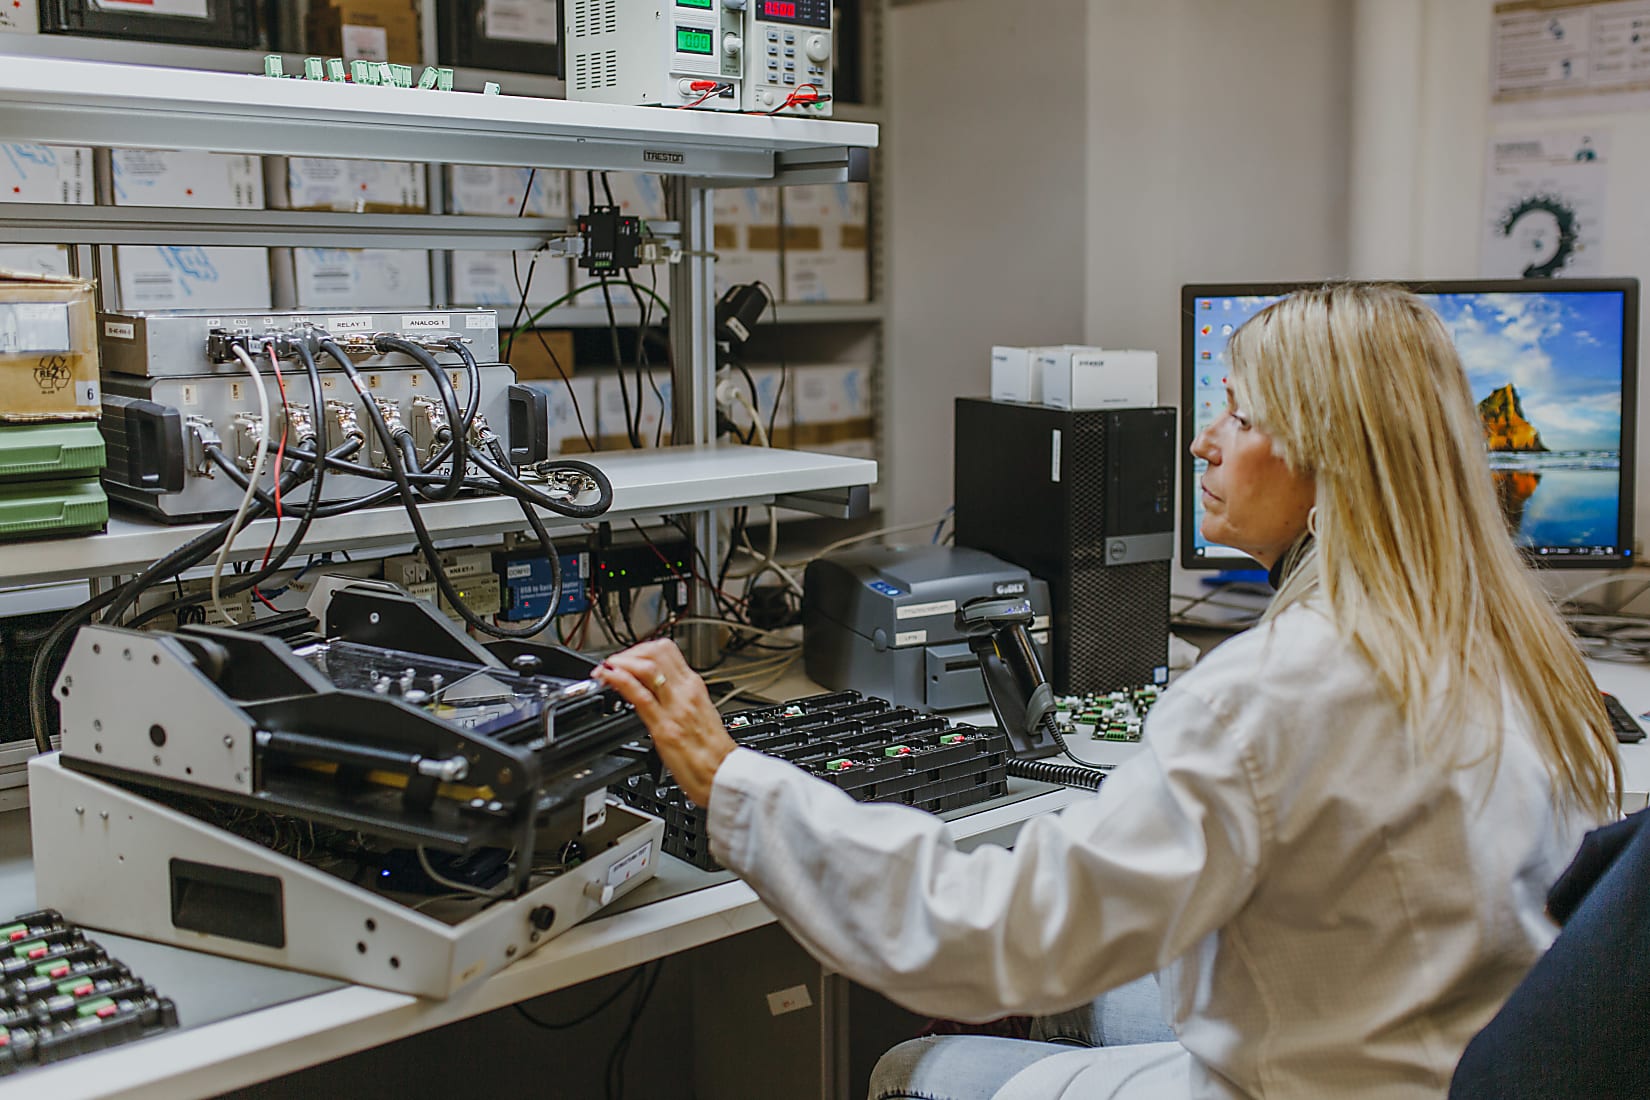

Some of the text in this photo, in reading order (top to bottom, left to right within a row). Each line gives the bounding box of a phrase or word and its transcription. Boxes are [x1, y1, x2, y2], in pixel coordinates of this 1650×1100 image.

[646, 151, 684, 162] TRESTON
[87, 388, 94, 400] 6
[473, 466, 479, 475] 1
